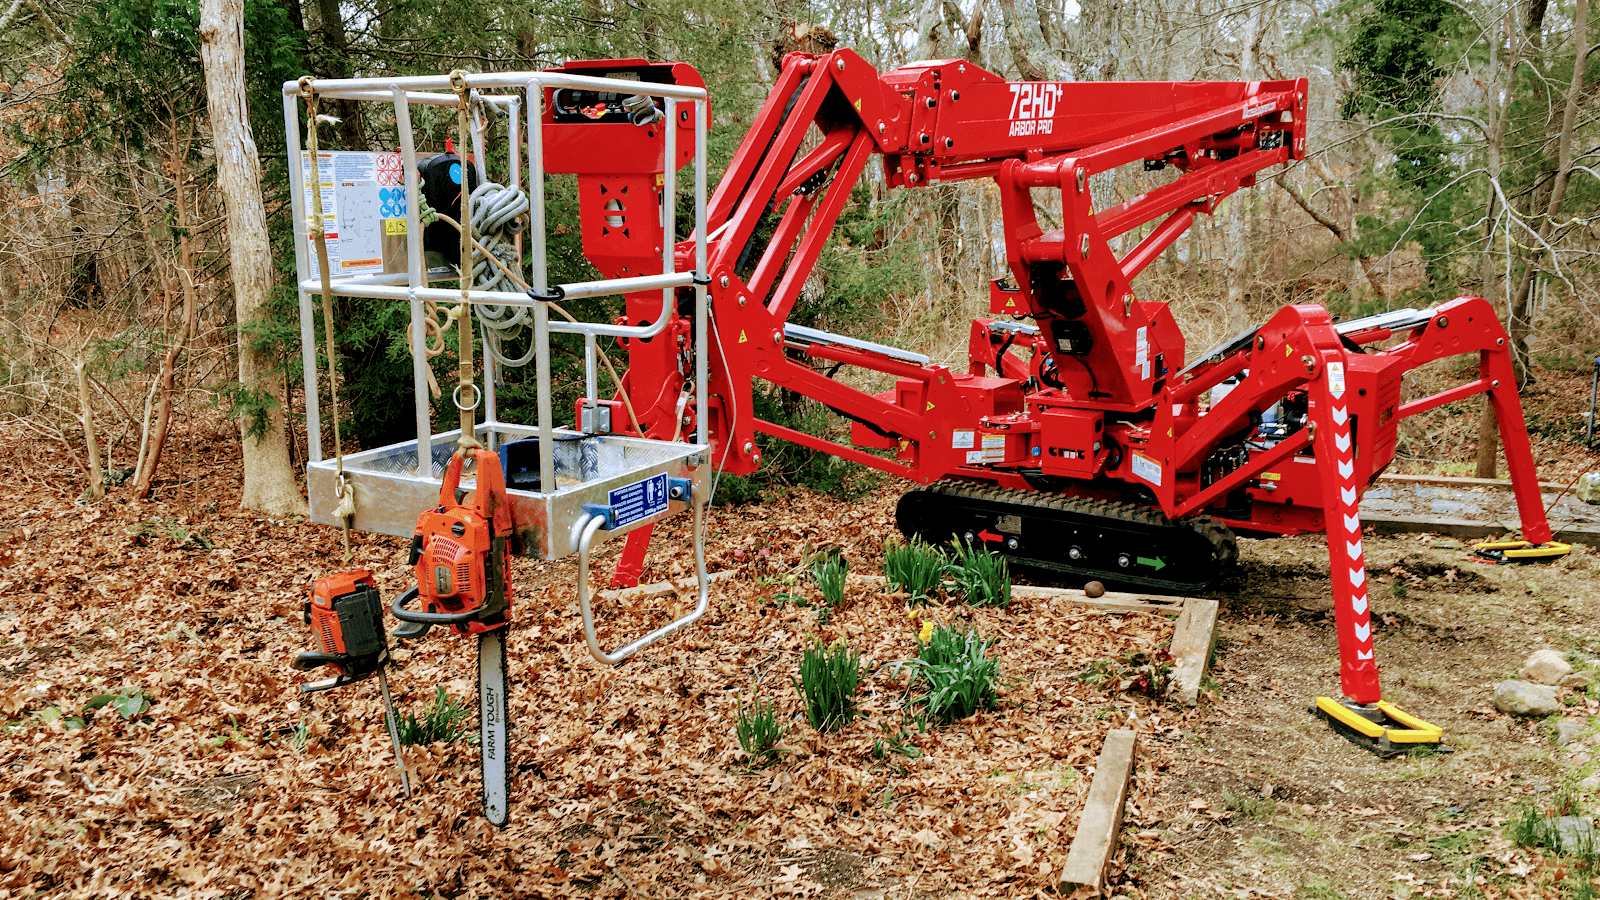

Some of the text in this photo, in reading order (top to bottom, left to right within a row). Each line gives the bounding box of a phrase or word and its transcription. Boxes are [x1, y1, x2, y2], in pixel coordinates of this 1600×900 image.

[1009, 84, 1063, 120] 72HD+
[1009, 119, 1053, 137] ARBOR PRO
[1049, 446, 1085, 459] cmc
[487, 730, 496, 760] FARM
